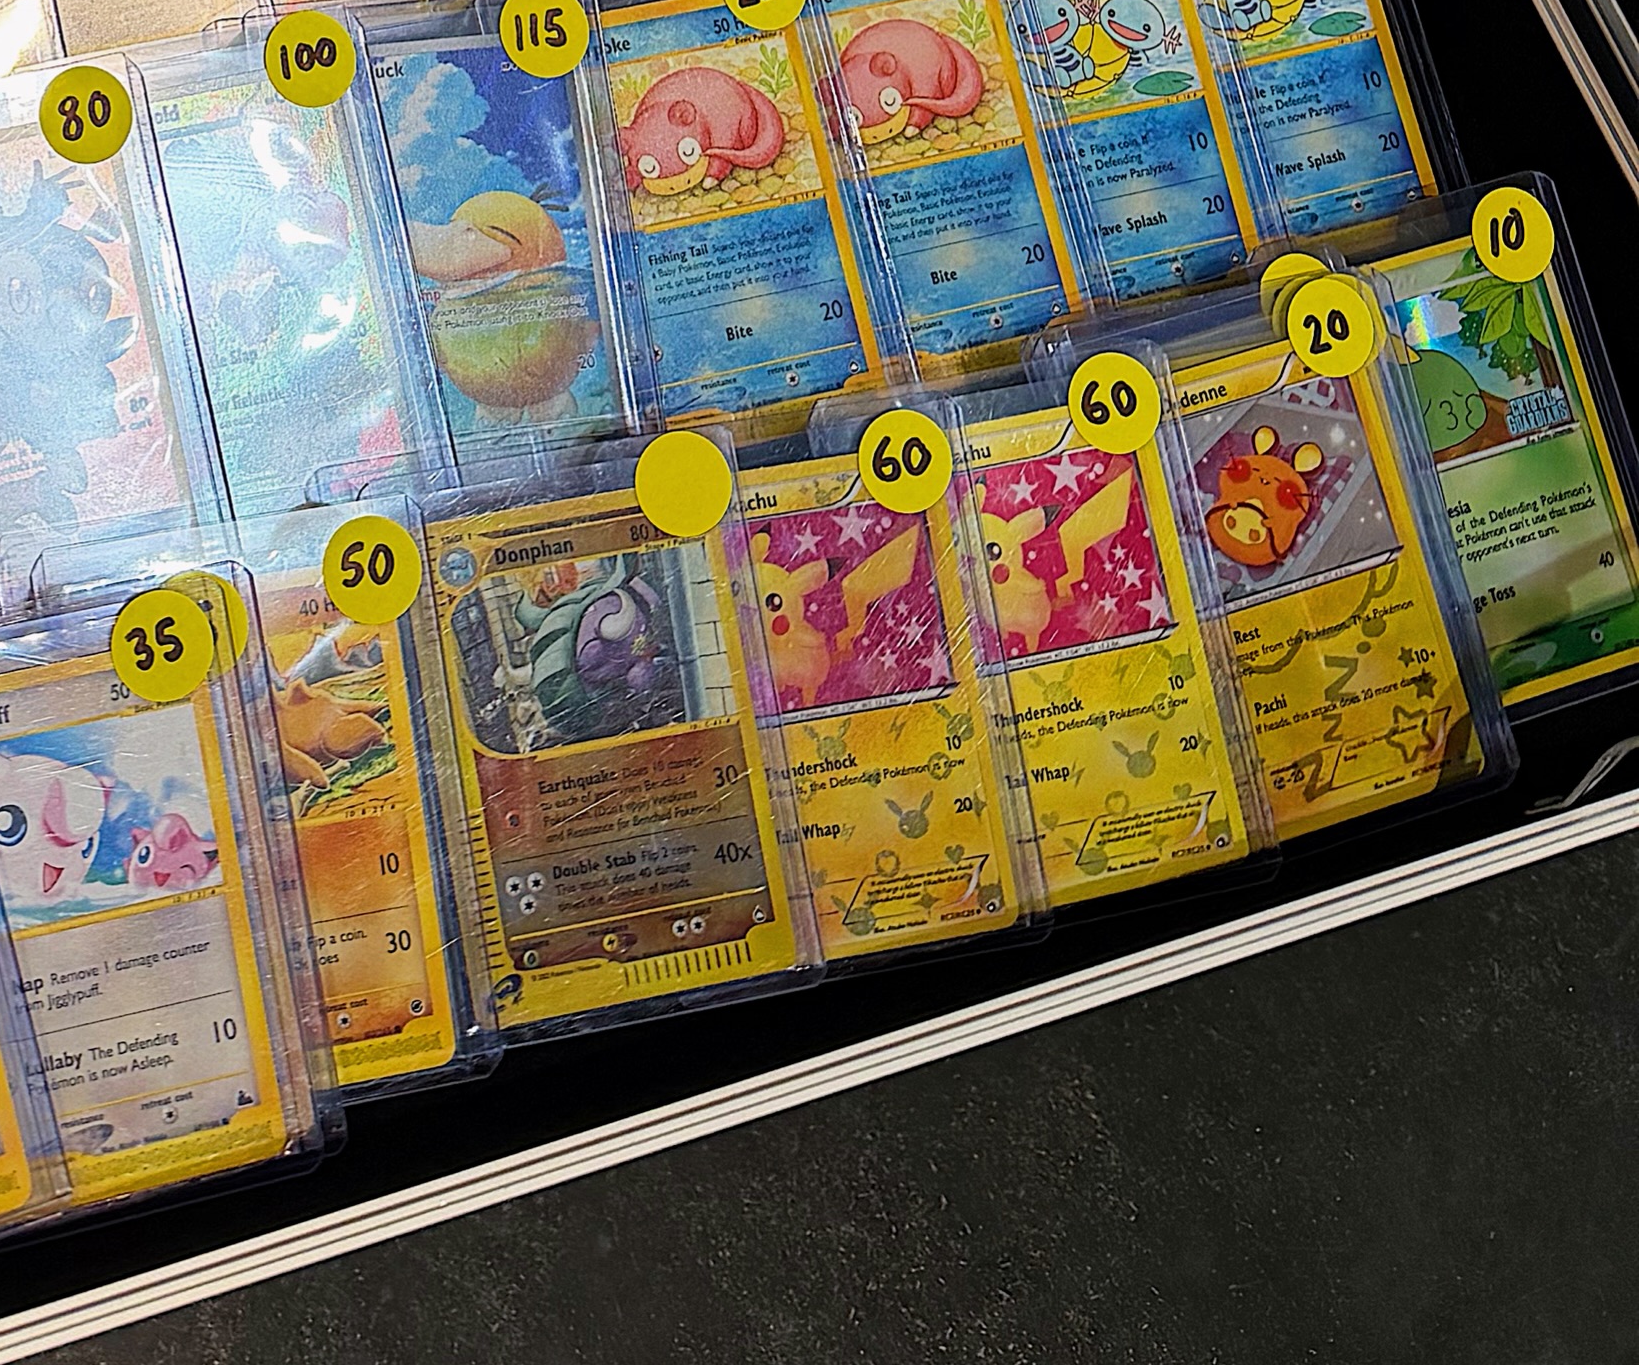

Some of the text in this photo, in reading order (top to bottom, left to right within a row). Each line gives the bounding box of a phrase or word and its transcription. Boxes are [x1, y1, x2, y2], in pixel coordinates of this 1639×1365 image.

[515, 9, 567, 49] 115
[280, 39, 337, 78] 100
[58, 91, 111, 141] 80
[1379, 133, 1400, 152] 20
[1305, 148, 1346, 169] Splash
[1203, 196, 1224, 215] 20
[1126, 211, 1168, 234] Splash
[1489, 208, 1525, 257] 10
[1022, 243, 1044, 264] 20
[931, 267, 958, 286] Bite
[820, 300, 843, 321] 20
[725, 323, 753, 342] Bite
[1304, 309, 1349, 355] 20
[1080, 380, 1137, 425] 60
[872, 436, 932, 482] 60
[340, 542, 395, 586] 50
[494, 538, 574, 565] Donphan
[1488, 583, 1516, 607] Toss
[124, 618, 183, 672] 35
[1254, 693, 1288, 717] Pachi
[1030, 764, 1071, 785] Whap
[212, 1018, 237, 1044] 10
